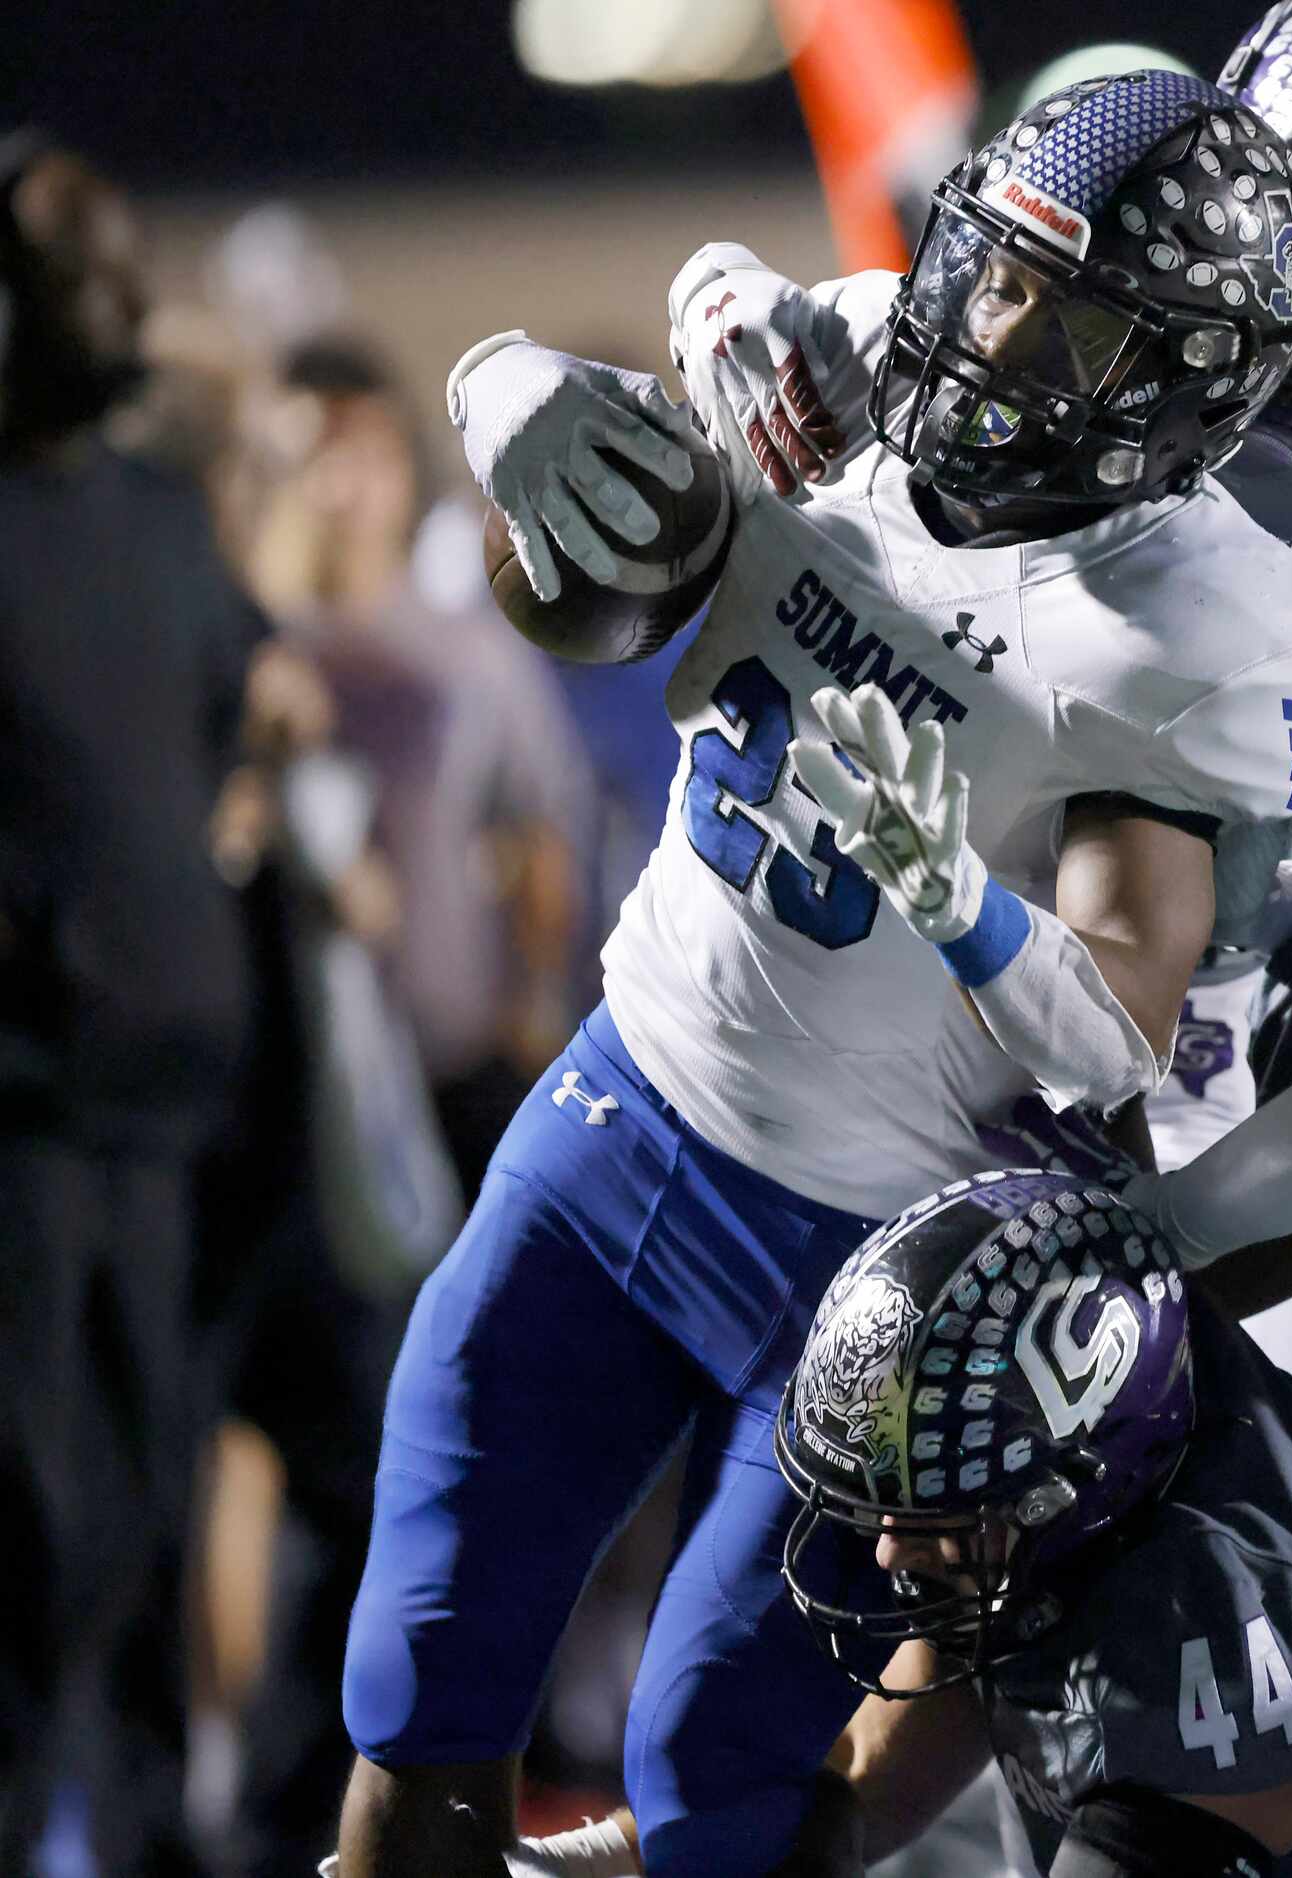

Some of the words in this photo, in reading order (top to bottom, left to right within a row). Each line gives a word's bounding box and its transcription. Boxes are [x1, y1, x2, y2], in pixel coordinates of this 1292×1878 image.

[1003, 182, 1080, 240] Riddell
[776, 568, 968, 731] SUMMIT
[825, 1448, 856, 1473] STATION
